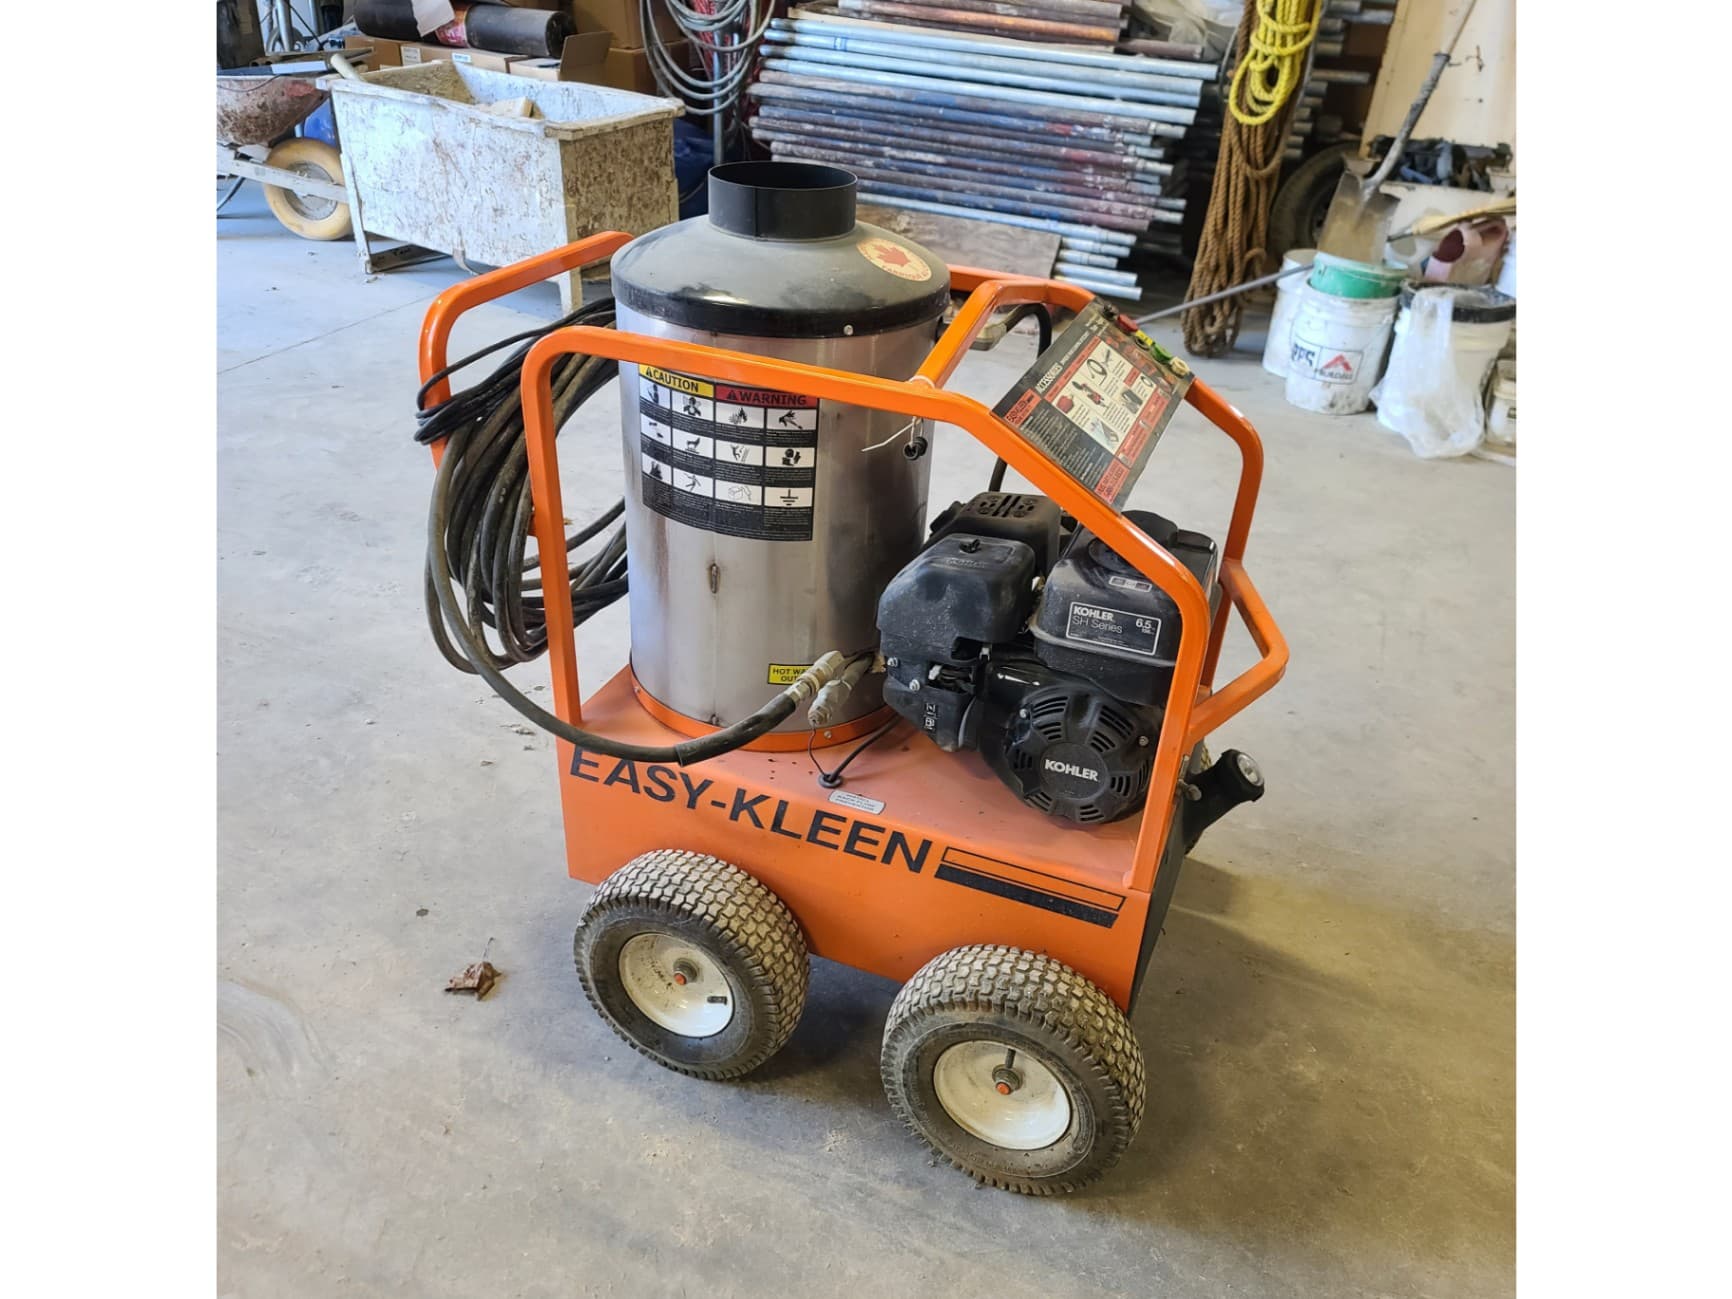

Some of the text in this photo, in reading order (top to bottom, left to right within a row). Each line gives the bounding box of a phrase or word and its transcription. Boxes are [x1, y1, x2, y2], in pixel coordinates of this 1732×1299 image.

[652, 369, 699, 393] CAUTION
[738, 390, 807, 406] WARNING
[1073, 605, 1115, 622] KOHLER
[1072, 615, 1123, 634] SH Series
[773, 668, 791, 676] HOT
[1045, 758, 1099, 782] KOHLER
[569, 745, 932, 874] EASY-KLEEN
